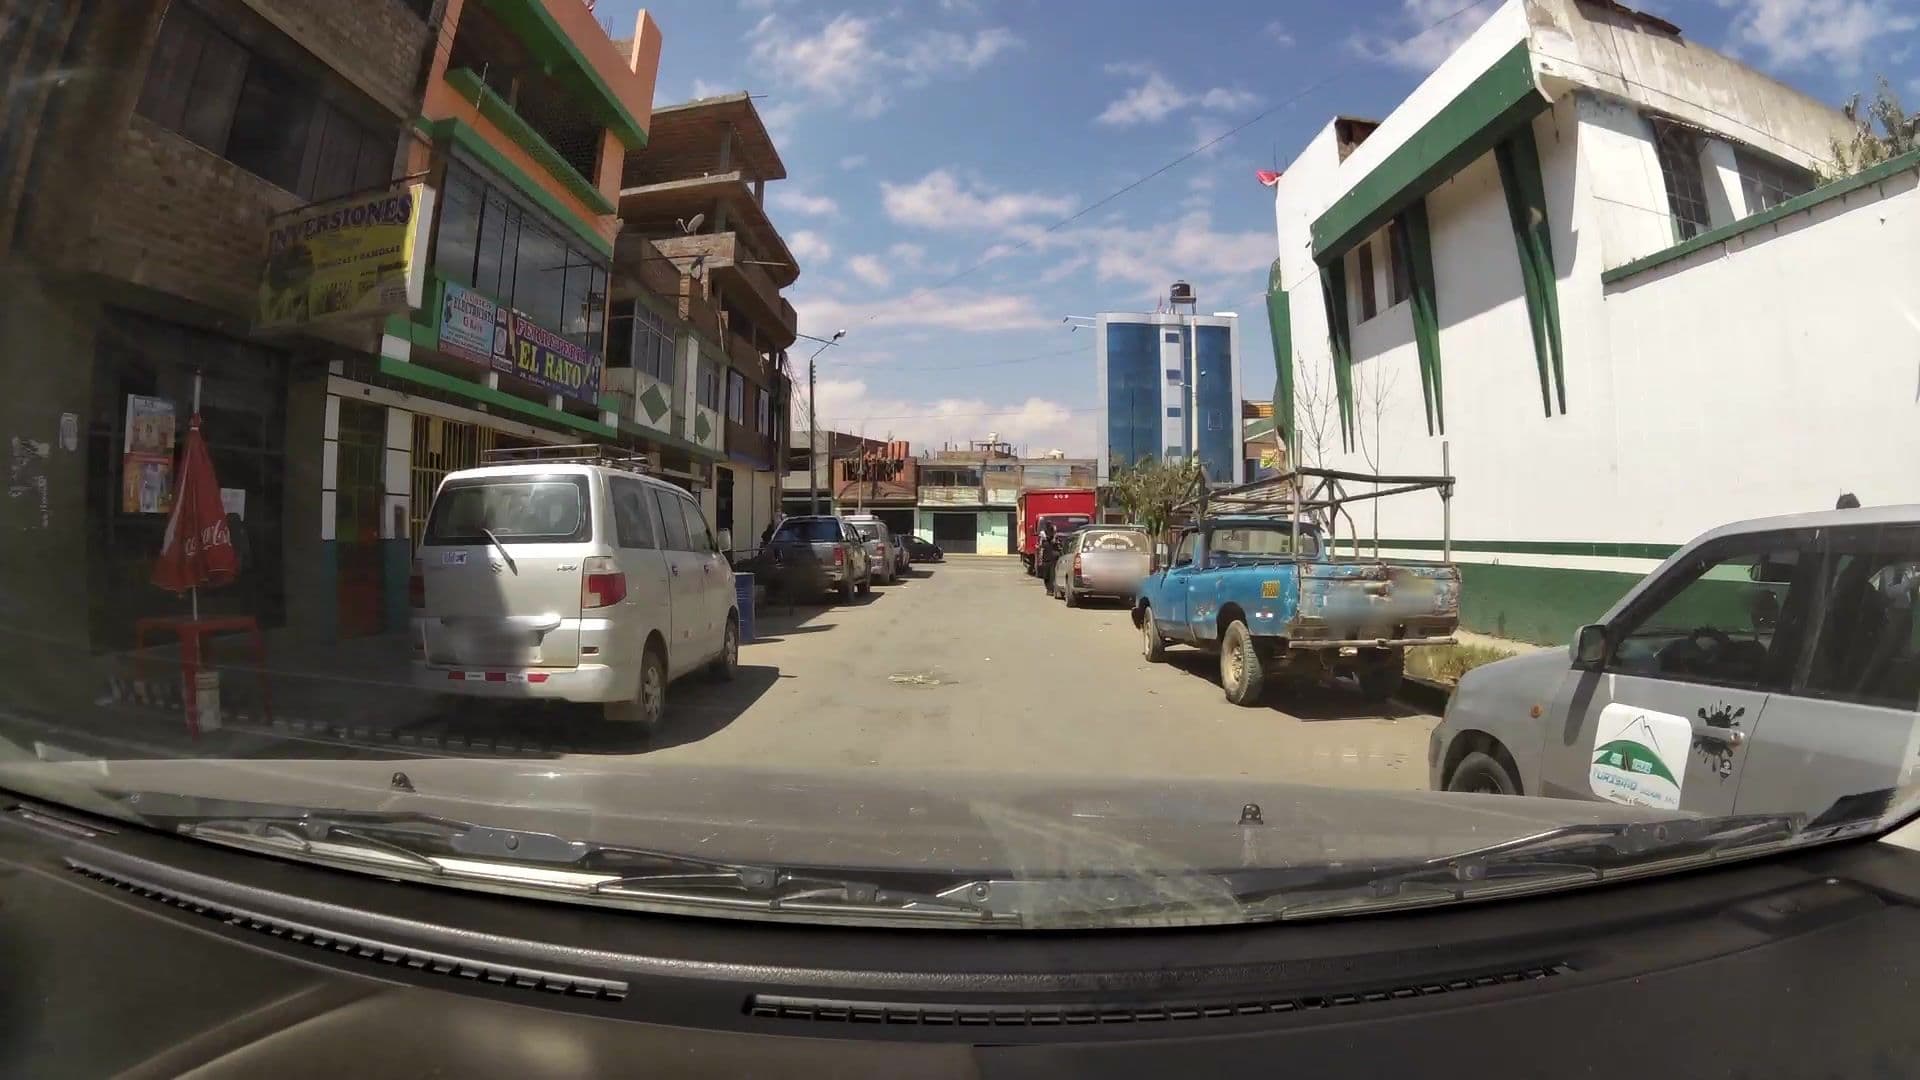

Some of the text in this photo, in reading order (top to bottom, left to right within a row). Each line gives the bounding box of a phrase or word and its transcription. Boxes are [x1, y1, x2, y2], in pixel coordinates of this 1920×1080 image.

[270, 194, 412, 250] INVERSIONES
[518, 339, 540, 374] EL
[545, 351, 581, 390] RAYO
